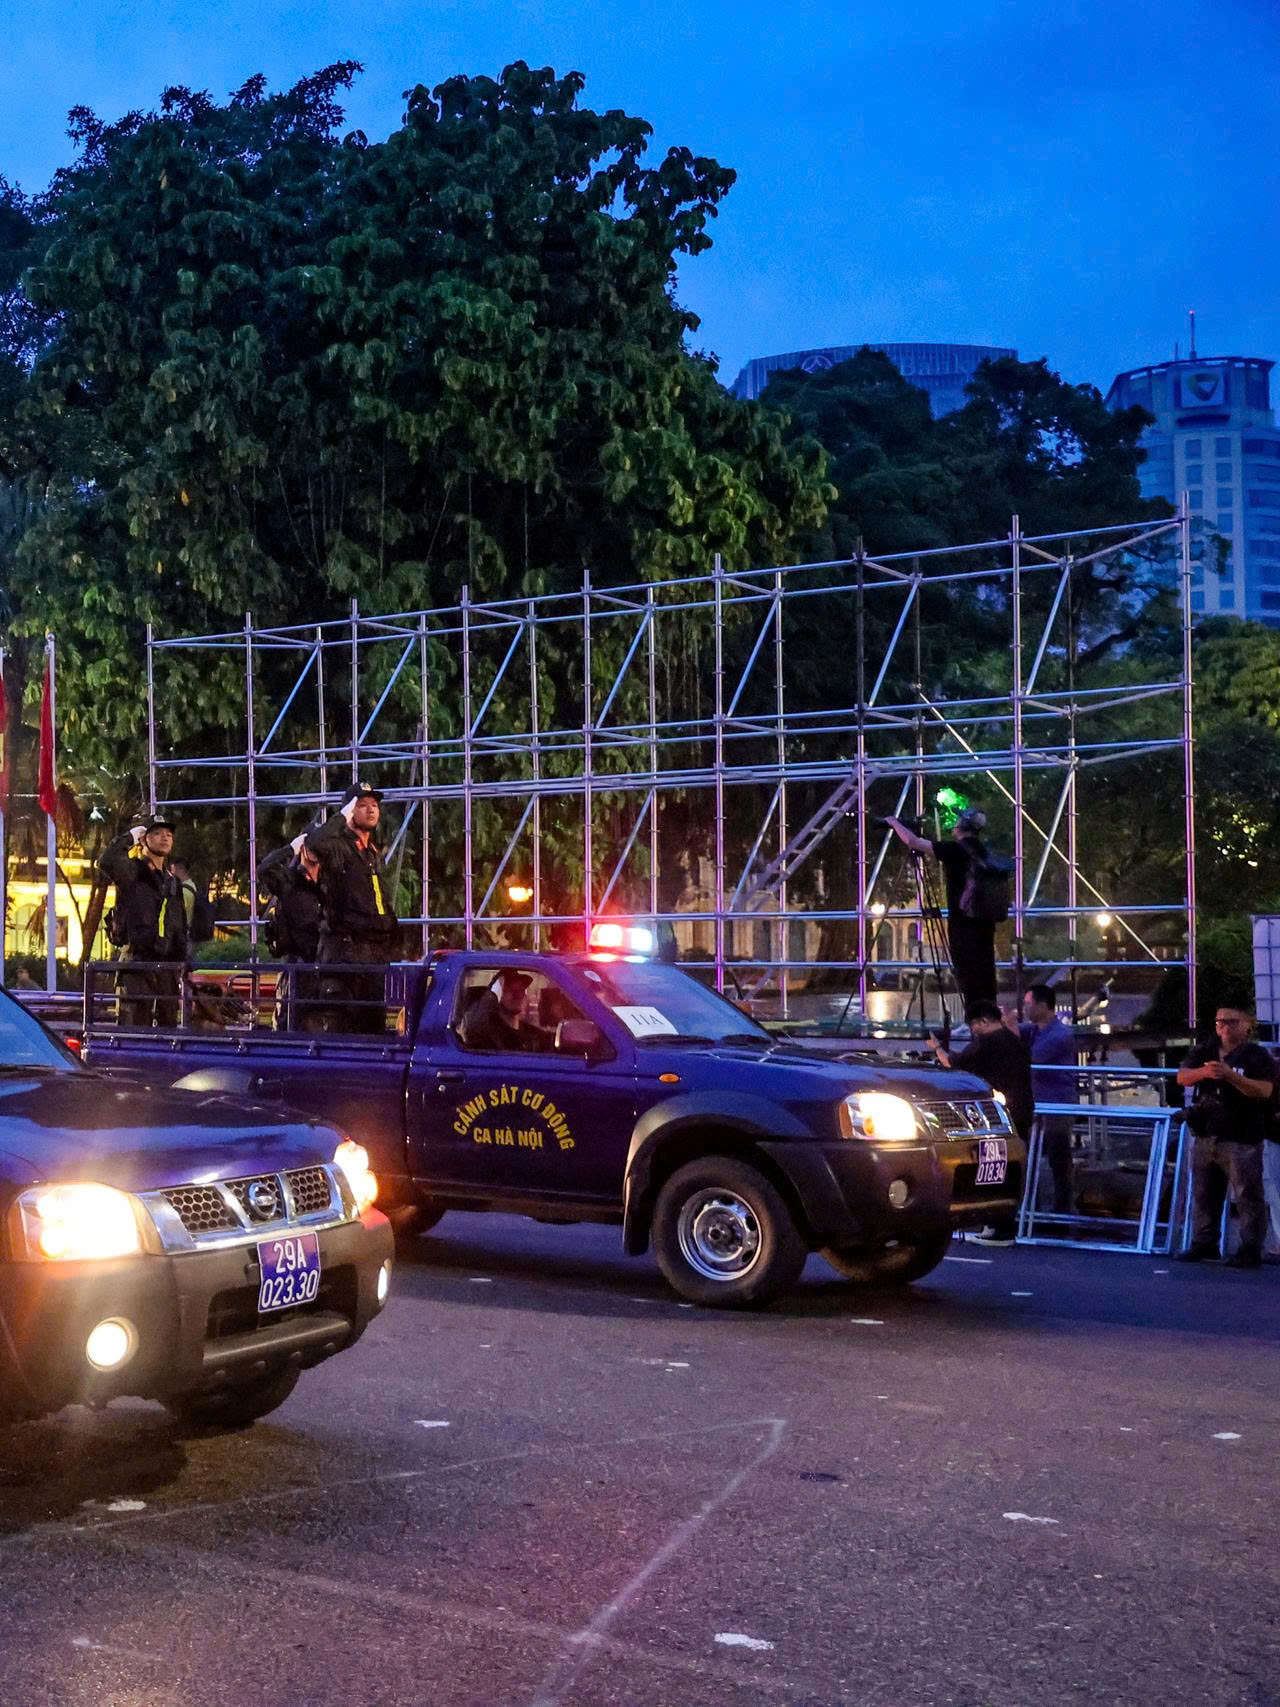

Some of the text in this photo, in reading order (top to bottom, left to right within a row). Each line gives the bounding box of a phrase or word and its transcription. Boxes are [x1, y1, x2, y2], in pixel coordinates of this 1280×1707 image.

[453, 1083, 575, 1149] CẢNH SÁT CƠ ĐỘNG
[473, 1126, 543, 1149] CA HÀ NỘI
[985, 1142, 1001, 1161] 29A
[274, 1239, 307, 1272] 29A
[261, 1270, 318, 1308] 023.30
